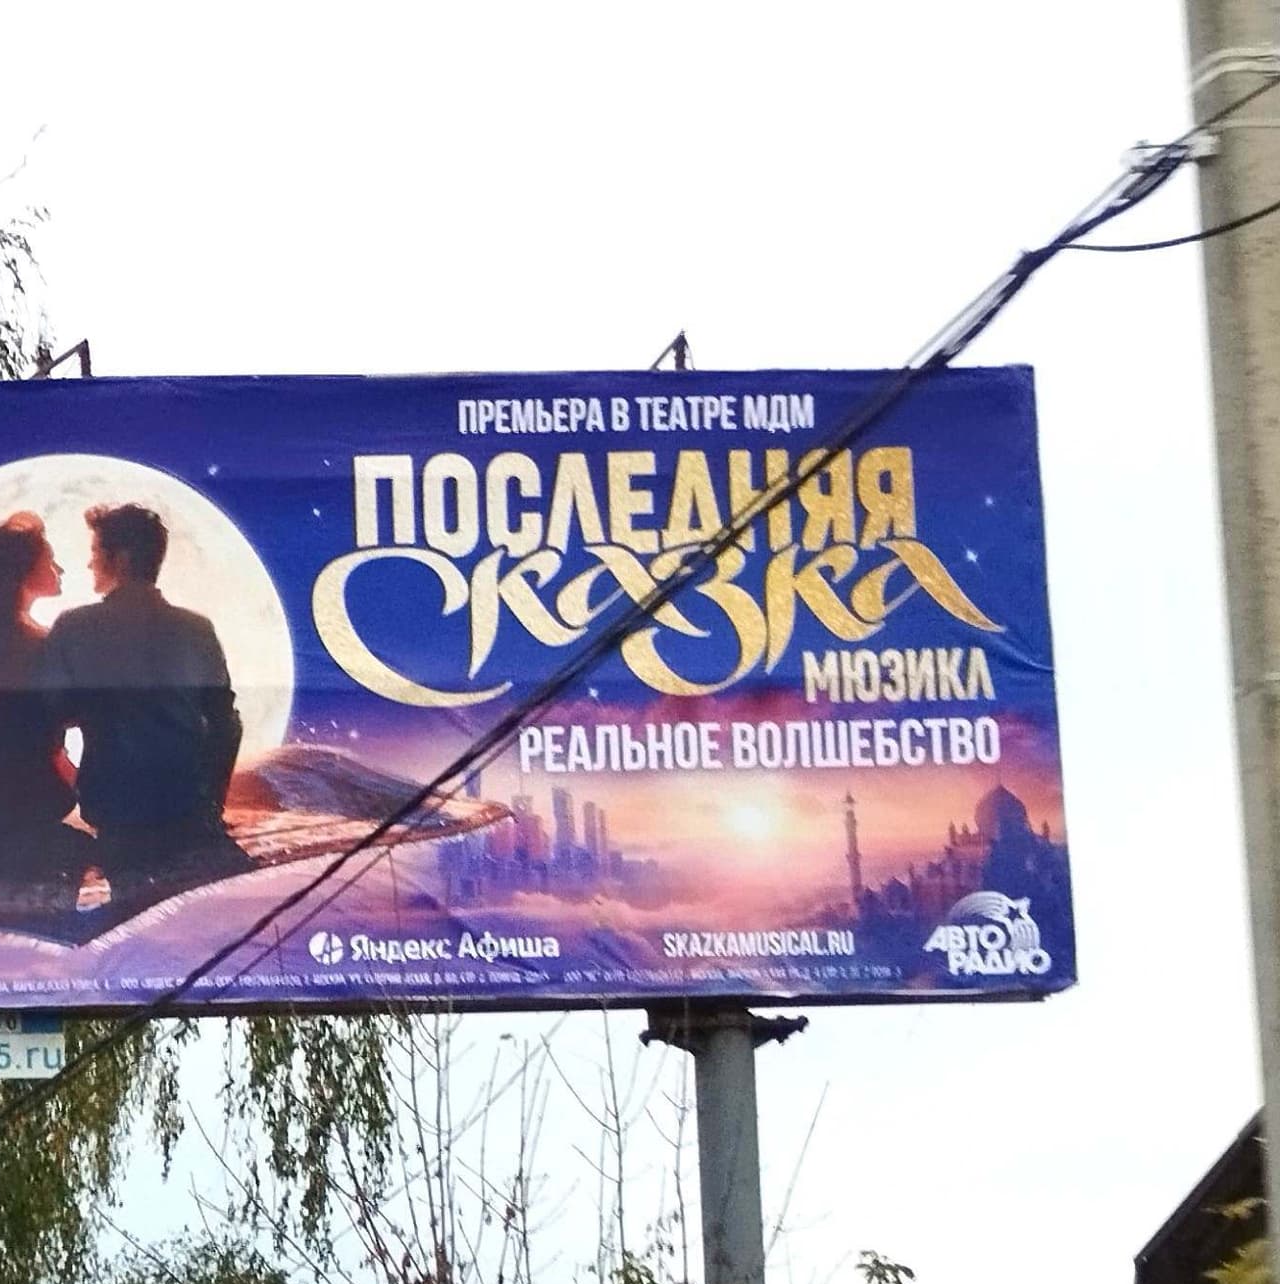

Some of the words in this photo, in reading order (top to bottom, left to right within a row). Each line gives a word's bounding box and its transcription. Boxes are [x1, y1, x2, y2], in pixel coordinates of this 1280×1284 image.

[458, 398, 605, 434] ПРЕМЬЕРА
[610, 397, 630, 432] В
[635, 395, 737, 432] ТЕАТРЕ
[743, 393, 815, 433] МДМ
[352, 447, 917, 558] ПОСЛЕДНЯЯ
[802, 647, 995, 703] МЮЗИКЛ
[519, 721, 725, 773] РЕАЛЬНОЕ
[731, 716, 1002, 770] ВОЛШЕБСТВО
[350, 934, 453, 963] Яндекс
[457, 931, 561, 962] Афиша
[662, 930, 856, 958] SKAZKAMUSICAL.RU
[922, 924, 1007, 952] АВТО
[947, 948, 1052, 975] РАДИО
